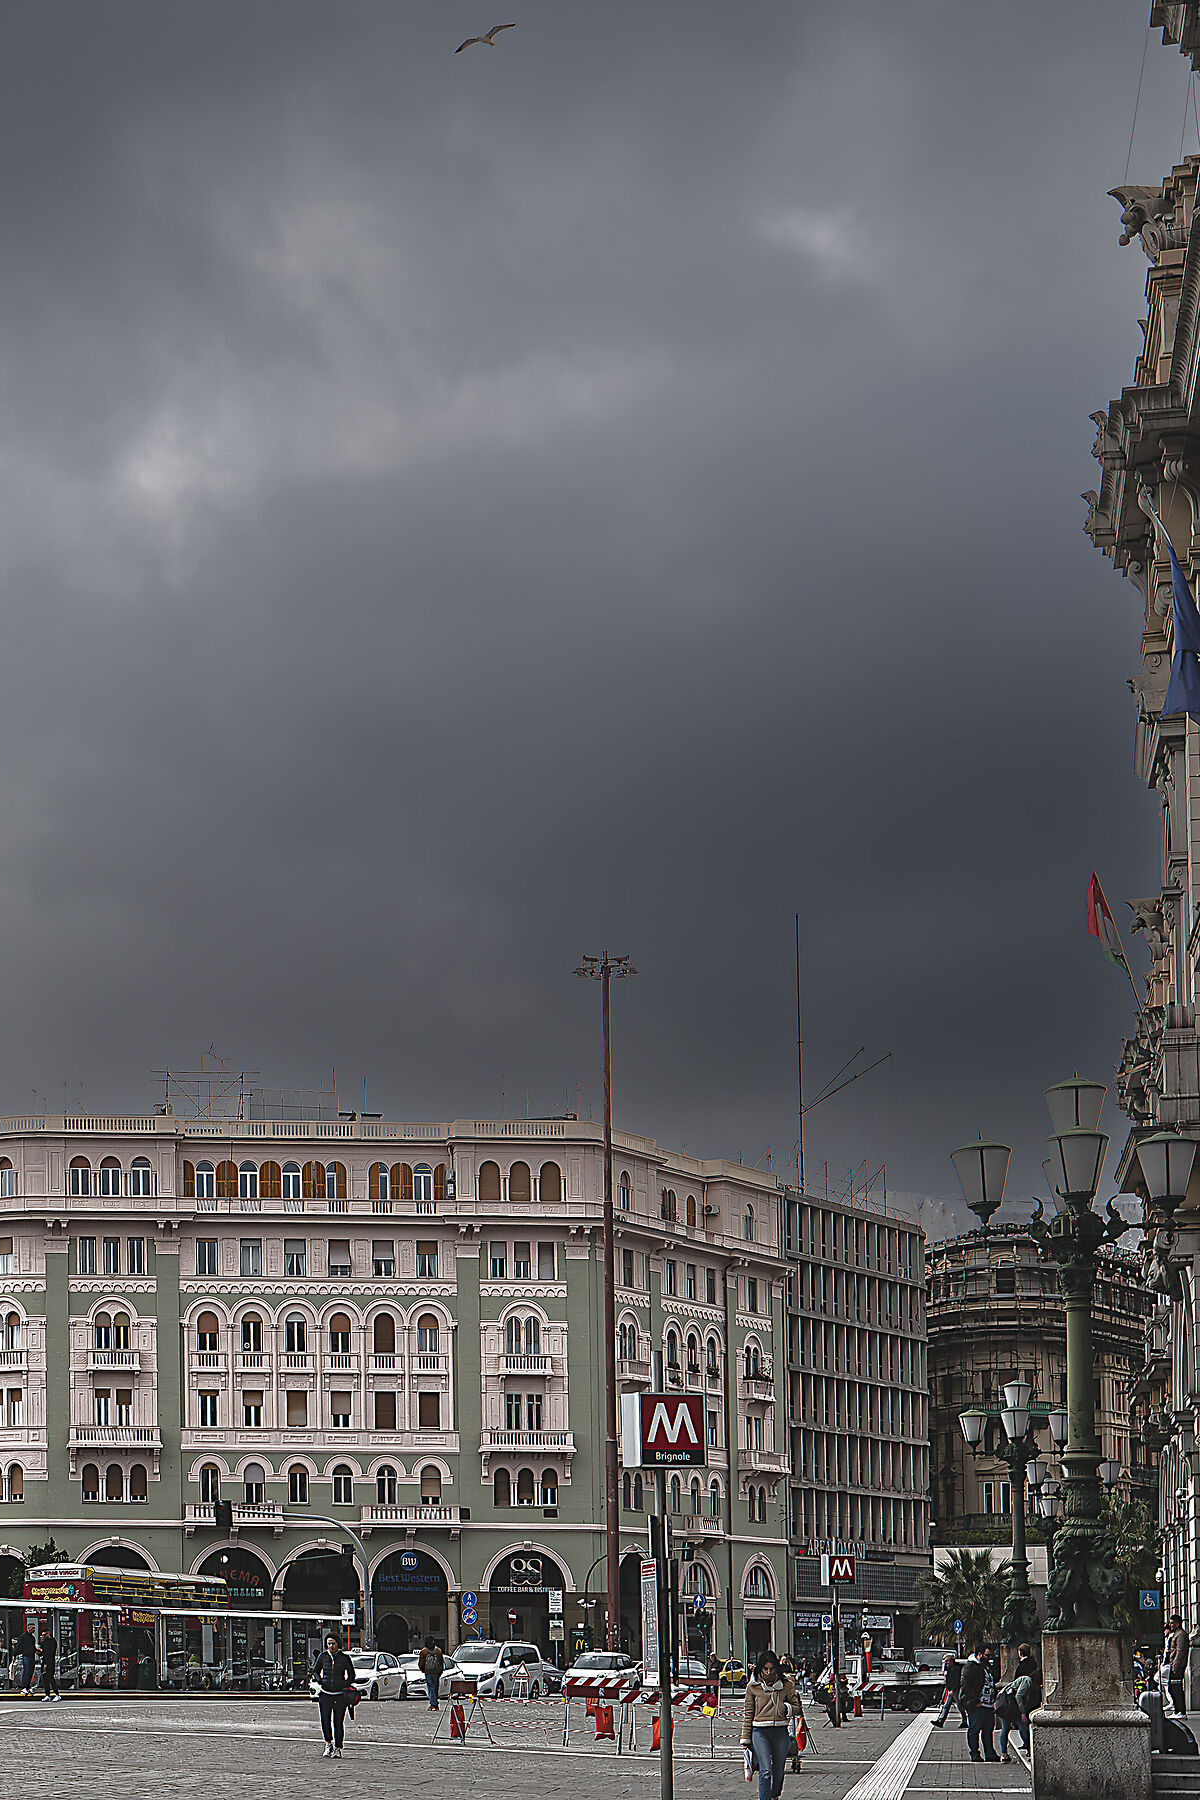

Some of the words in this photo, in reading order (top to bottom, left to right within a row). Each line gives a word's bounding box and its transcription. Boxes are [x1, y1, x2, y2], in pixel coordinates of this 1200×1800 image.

[647, 1402, 699, 1444] M
[655, 1451, 691, 1463] Brignole
[832, 1540, 866, 1560] OMANI
[402, 1557, 417, 1566] BW
[831, 1559, 853, 1577] M
[378, 1573, 400, 1583] Best
[401, 1573, 441, 1583] Western
